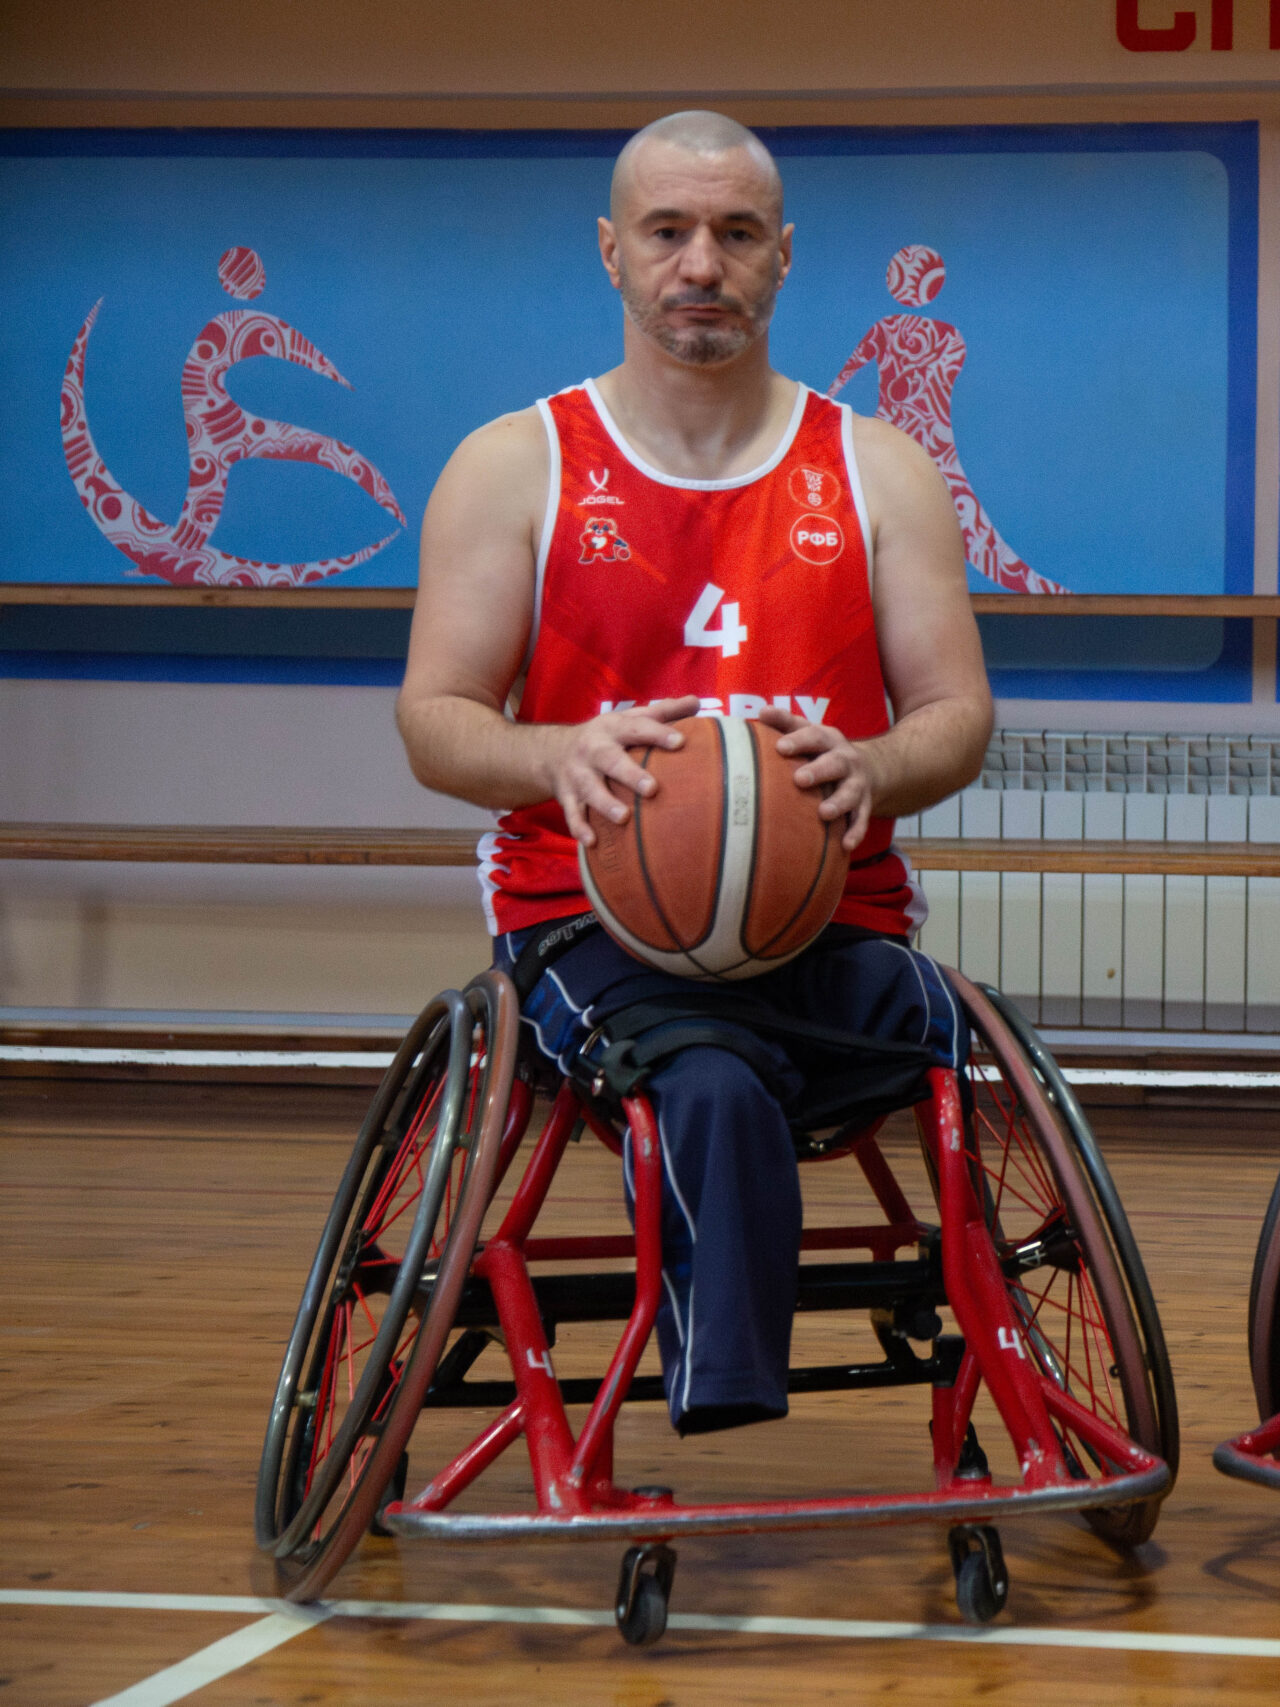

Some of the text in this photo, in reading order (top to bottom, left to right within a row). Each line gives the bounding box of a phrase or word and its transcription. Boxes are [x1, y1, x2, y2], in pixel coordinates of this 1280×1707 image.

[797, 530, 838, 546] РФБ
[684, 582, 748, 658] 4
[998, 1326, 1025, 1359] 4
[526, 1347, 554, 1379] 4
